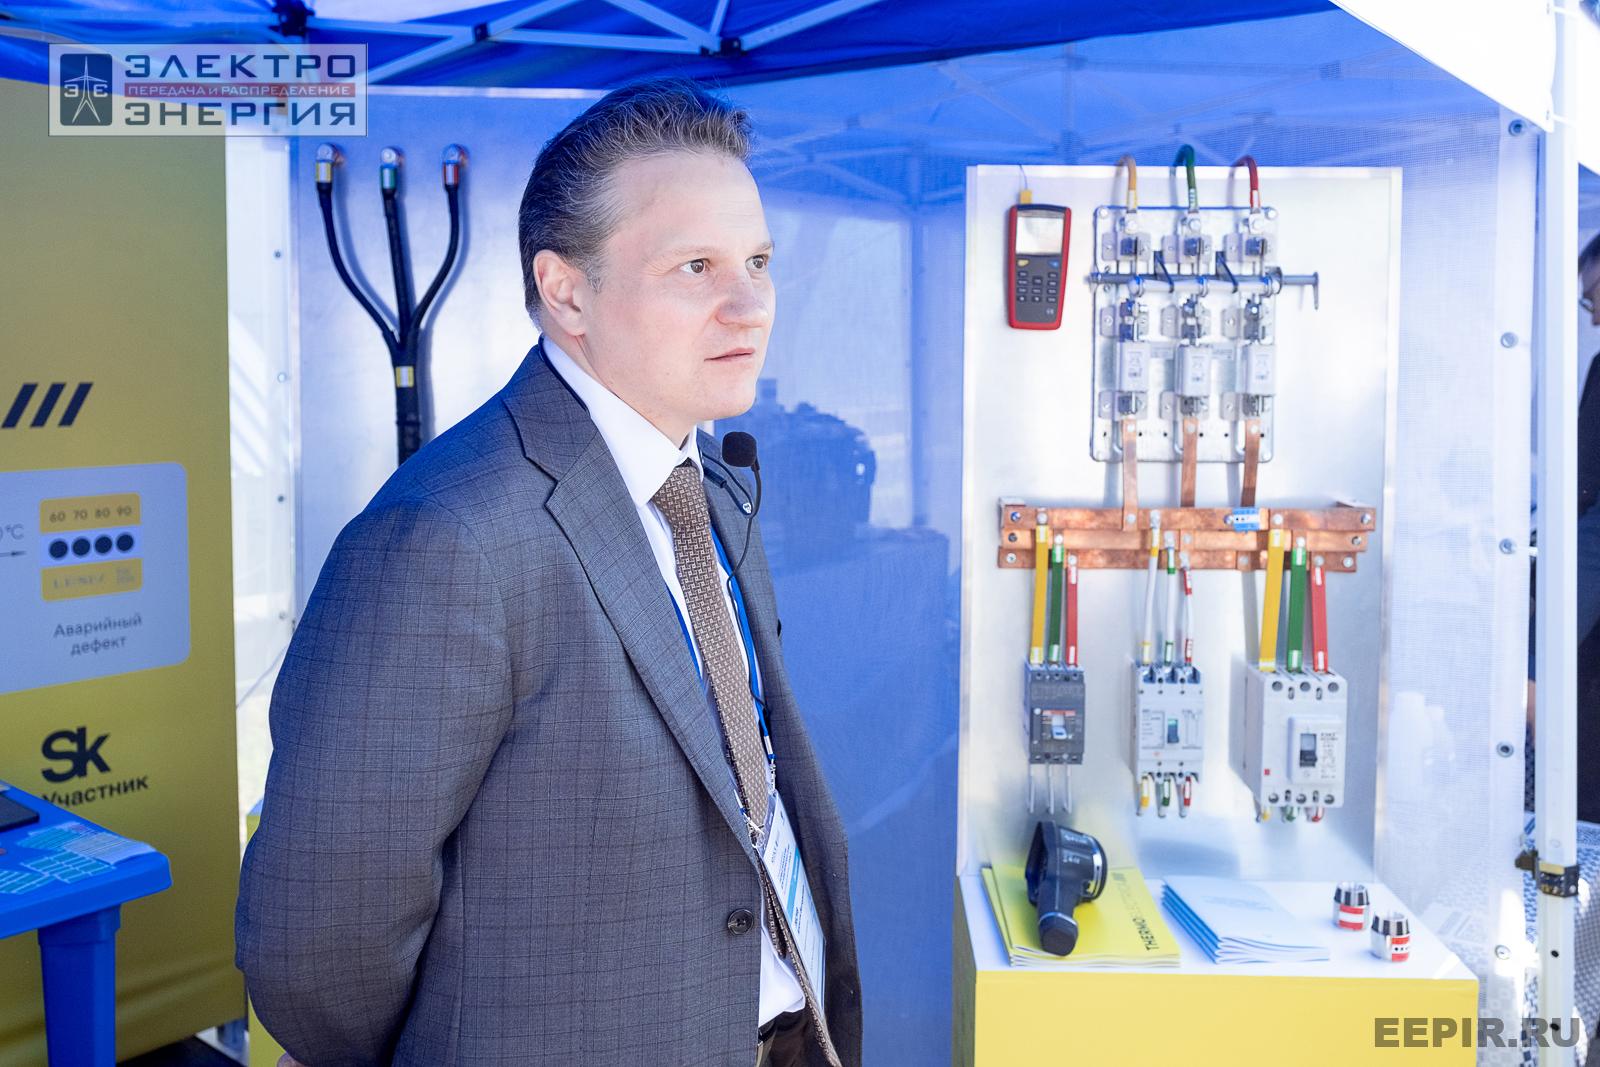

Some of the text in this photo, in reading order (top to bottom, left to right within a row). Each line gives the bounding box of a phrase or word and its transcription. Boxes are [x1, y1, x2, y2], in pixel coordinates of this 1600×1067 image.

[49, 505, 132, 523] 60 70 80 90
[53, 612, 143, 638] Аварийный
[70, 634, 127, 657] дефект
[41, 726, 111, 783] Sk
